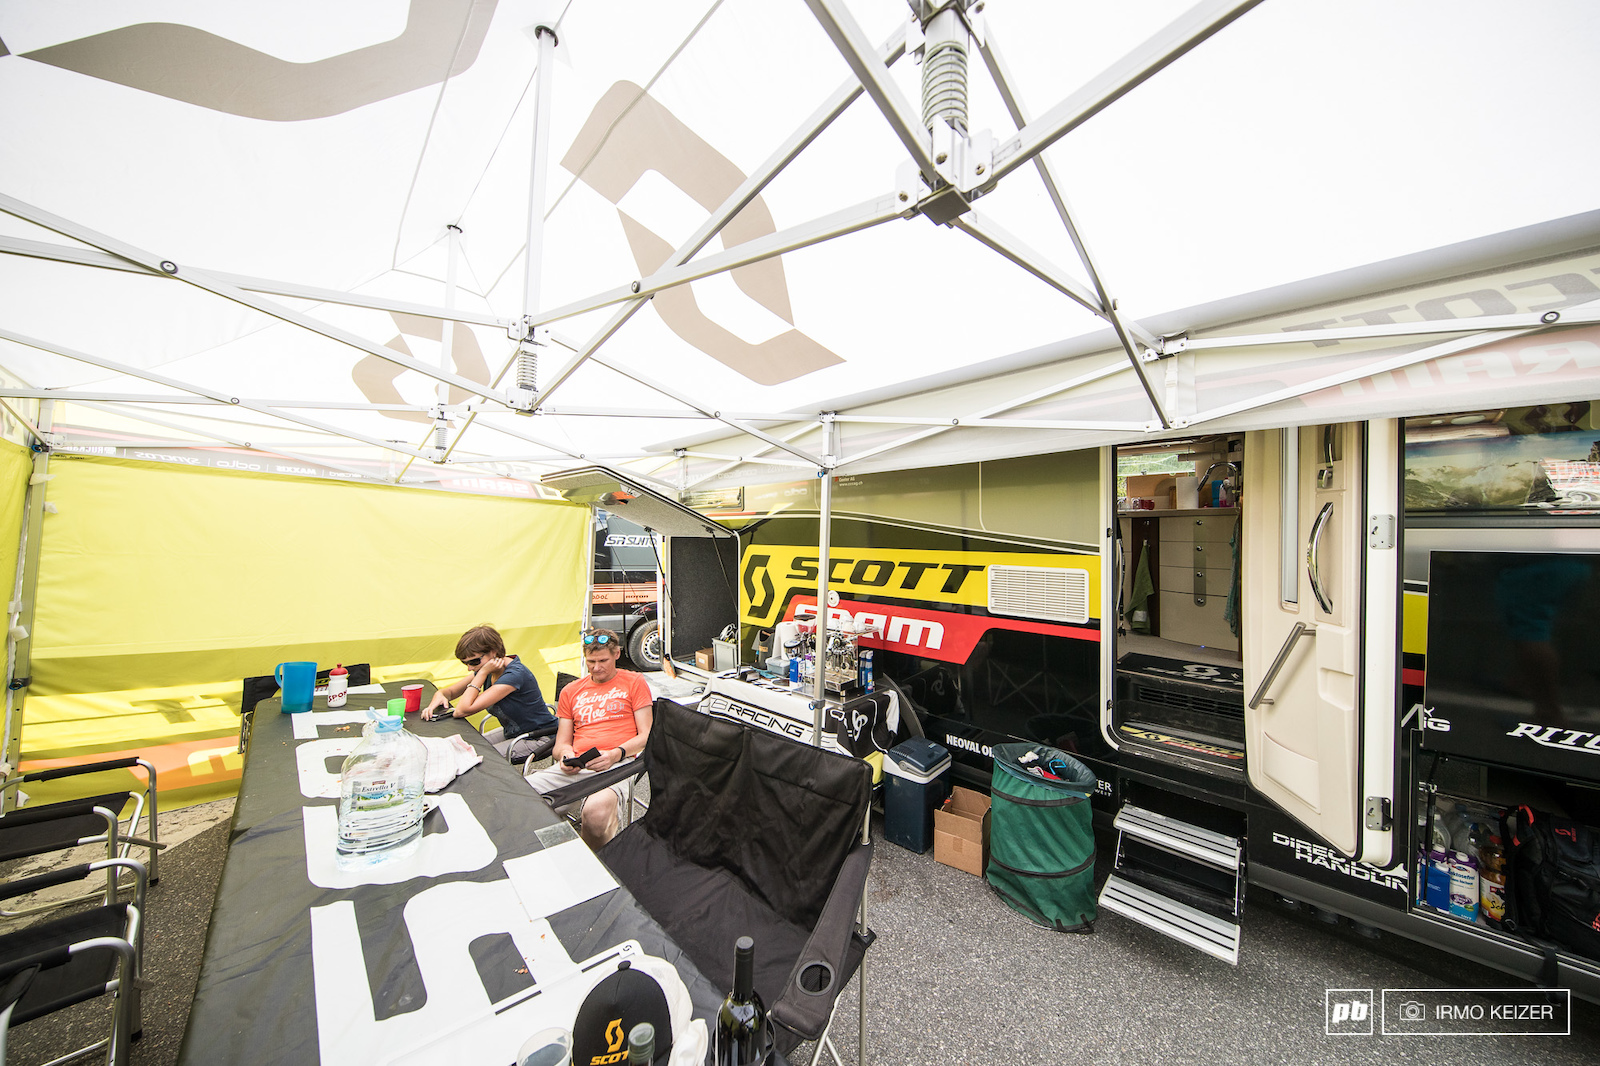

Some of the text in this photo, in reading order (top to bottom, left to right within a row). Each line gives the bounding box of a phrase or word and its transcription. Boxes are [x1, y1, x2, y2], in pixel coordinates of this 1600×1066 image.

[626, 536, 657, 547] SUNTO
[786, 556, 985, 594] SCOTT
[573, 687, 628, 710] Lexington
[579, 704, 606, 723] Ave
[727, 704, 804, 738] RACING
[946, 733, 981, 755] NEOVAL
[1096, 779, 1113, 793] ER
[1272, 832, 1346, 863] DIREC
[1490, 900, 1505, 910] Sch
[590, 1050, 629, 1066] SCOT
